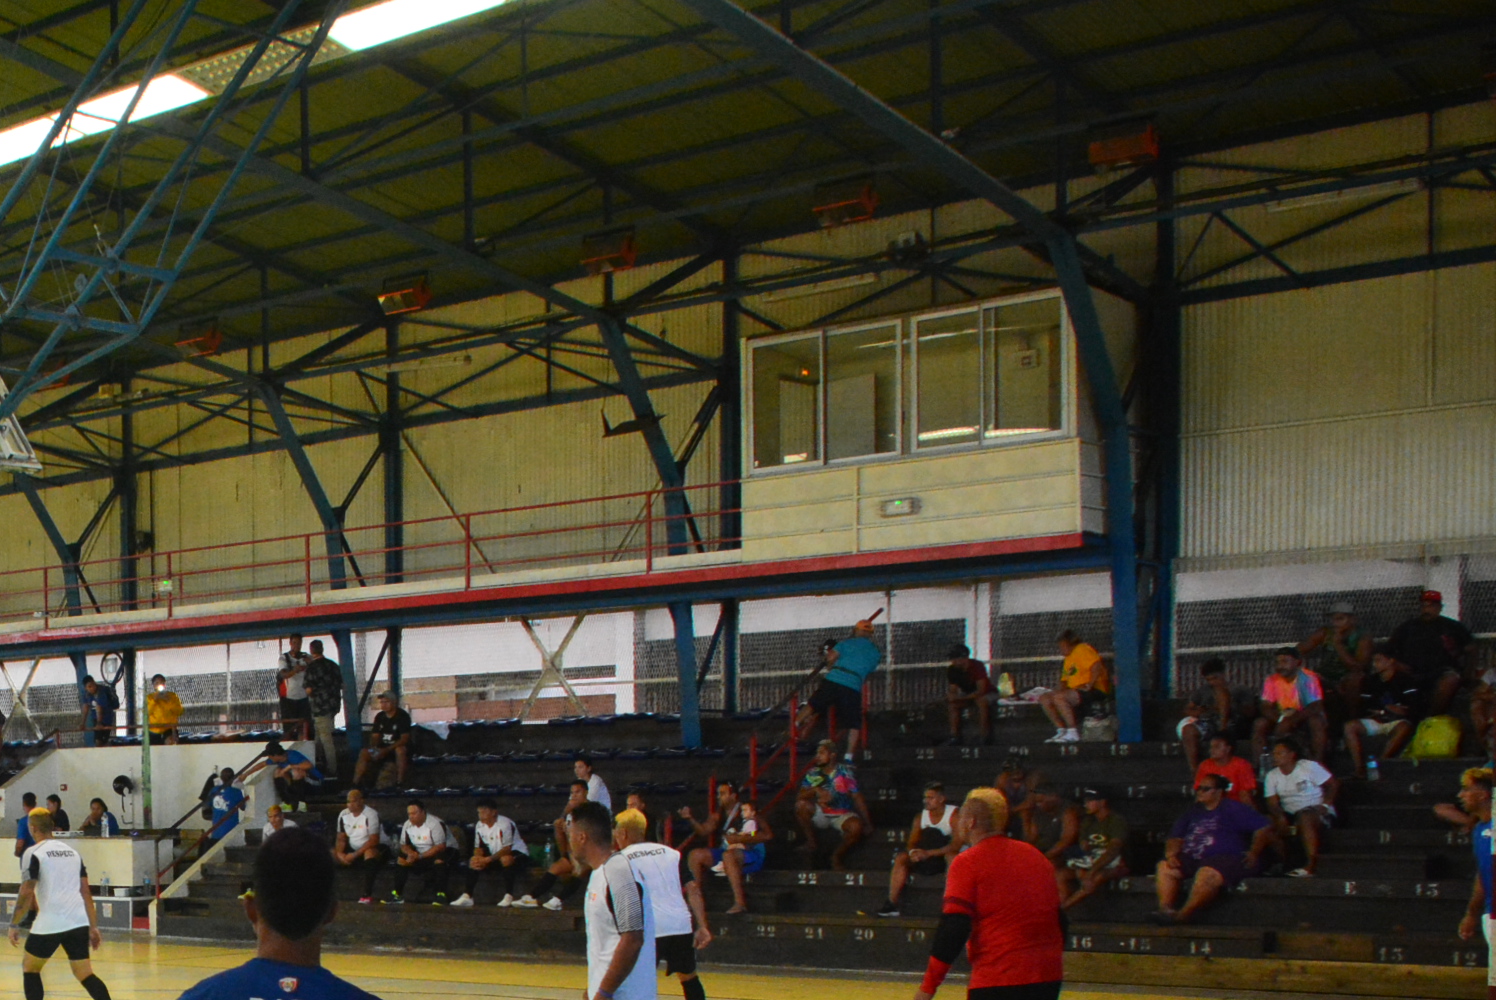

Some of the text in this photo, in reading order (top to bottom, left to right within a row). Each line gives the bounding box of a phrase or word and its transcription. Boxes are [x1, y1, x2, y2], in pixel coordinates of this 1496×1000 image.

[961, 748, 979, 758] 21
[1061, 745, 1079, 755] 19
[1110, 744, 1128, 755] 18
[887, 830, 905, 842] 21
[627, 848, 665, 860] RESPECT
[798, 873, 817, 885] 22
[846, 873, 865, 885] 21
[1344, 882, 1356, 894] E
[805, 928, 823, 939] 21
[854, 928, 876, 940] 20
[1072, 936, 1092, 949] 16
[1190, 941, 1211, 954] 14
[1453, 951, 1477, 965] 12
